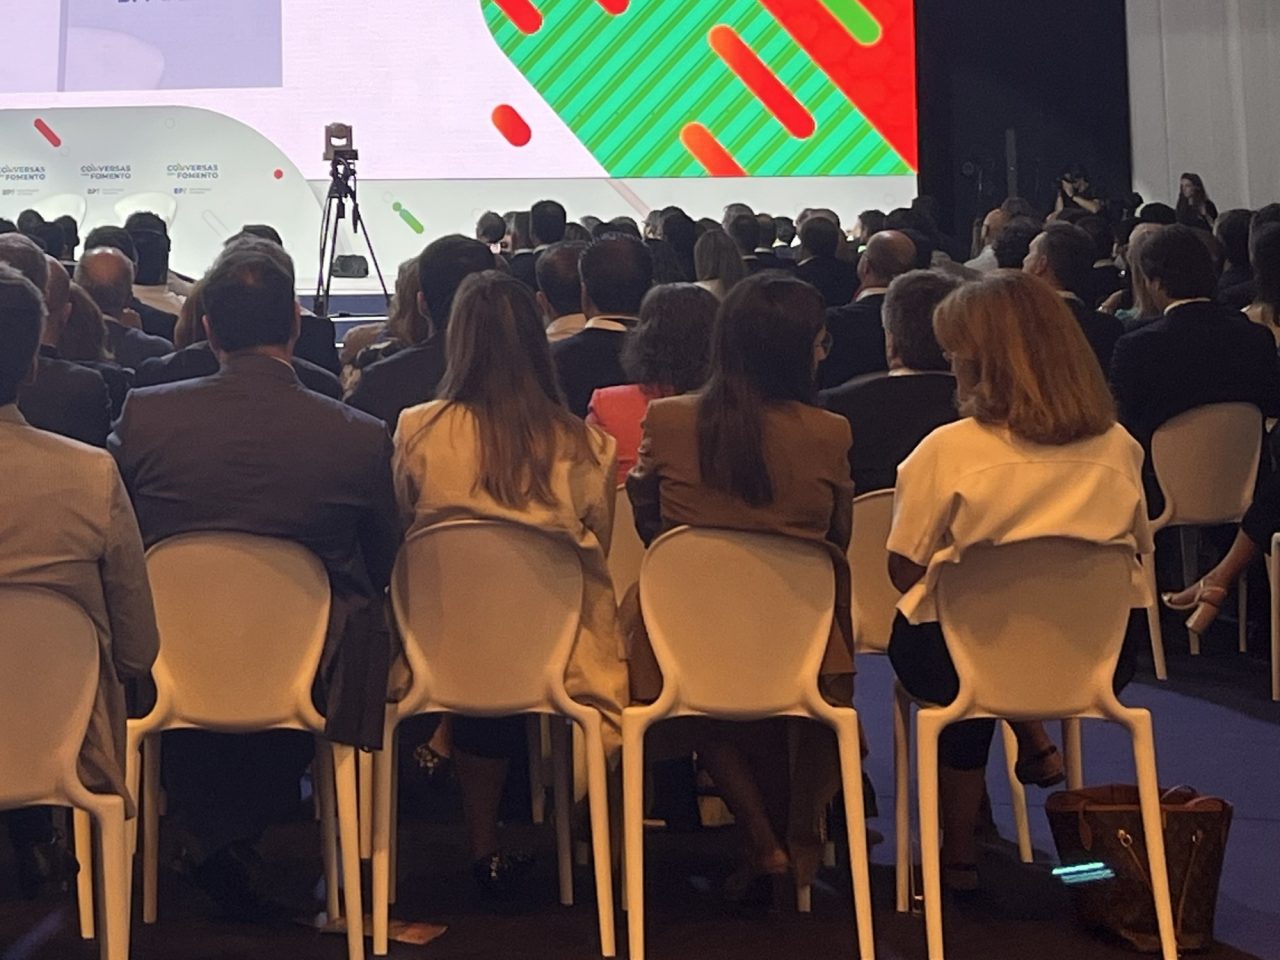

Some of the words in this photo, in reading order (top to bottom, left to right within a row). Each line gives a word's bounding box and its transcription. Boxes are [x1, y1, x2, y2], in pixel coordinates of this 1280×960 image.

[80, 163, 131, 173] CONVERSAS
[166, 162, 219, 172] CONVERSAS
[5, 173, 46, 181] FOMENTO
[90, 172, 131, 180] FOMENTO
[176, 171, 219, 179] FOMENTO
